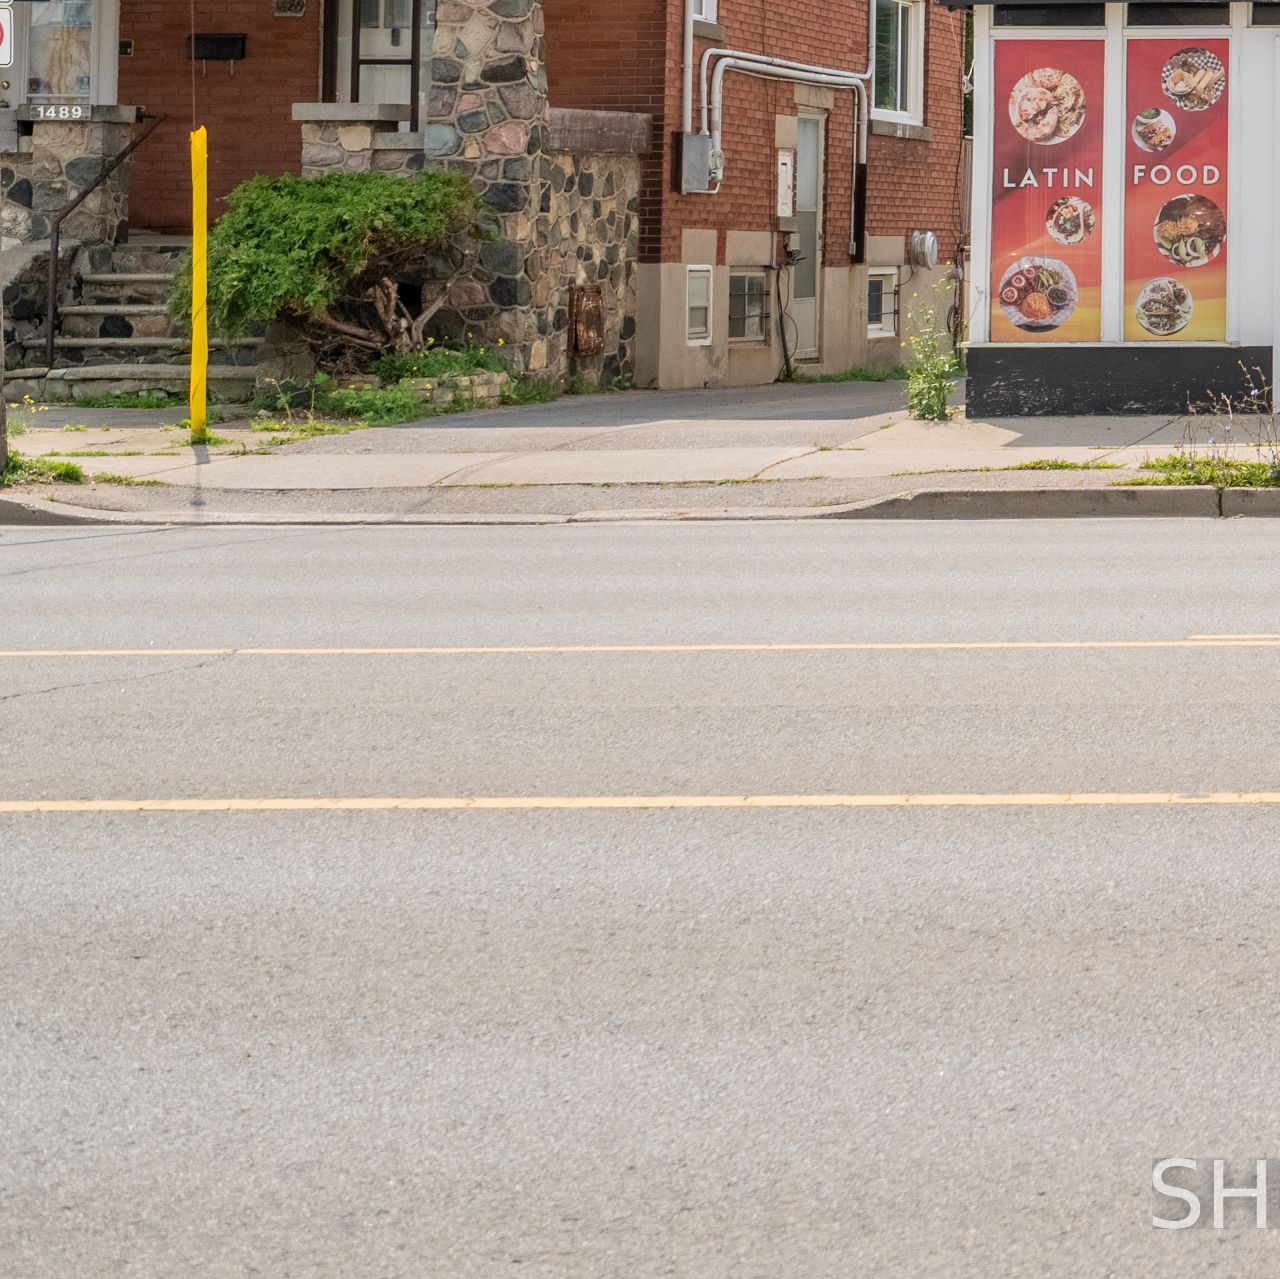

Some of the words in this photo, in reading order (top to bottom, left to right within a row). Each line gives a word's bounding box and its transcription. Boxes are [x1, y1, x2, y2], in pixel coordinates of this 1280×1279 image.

[37, 105, 82, 119] 1489
[1003, 167, 1094, 188] LATIN
[1133, 164, 1220, 186] FOOD
